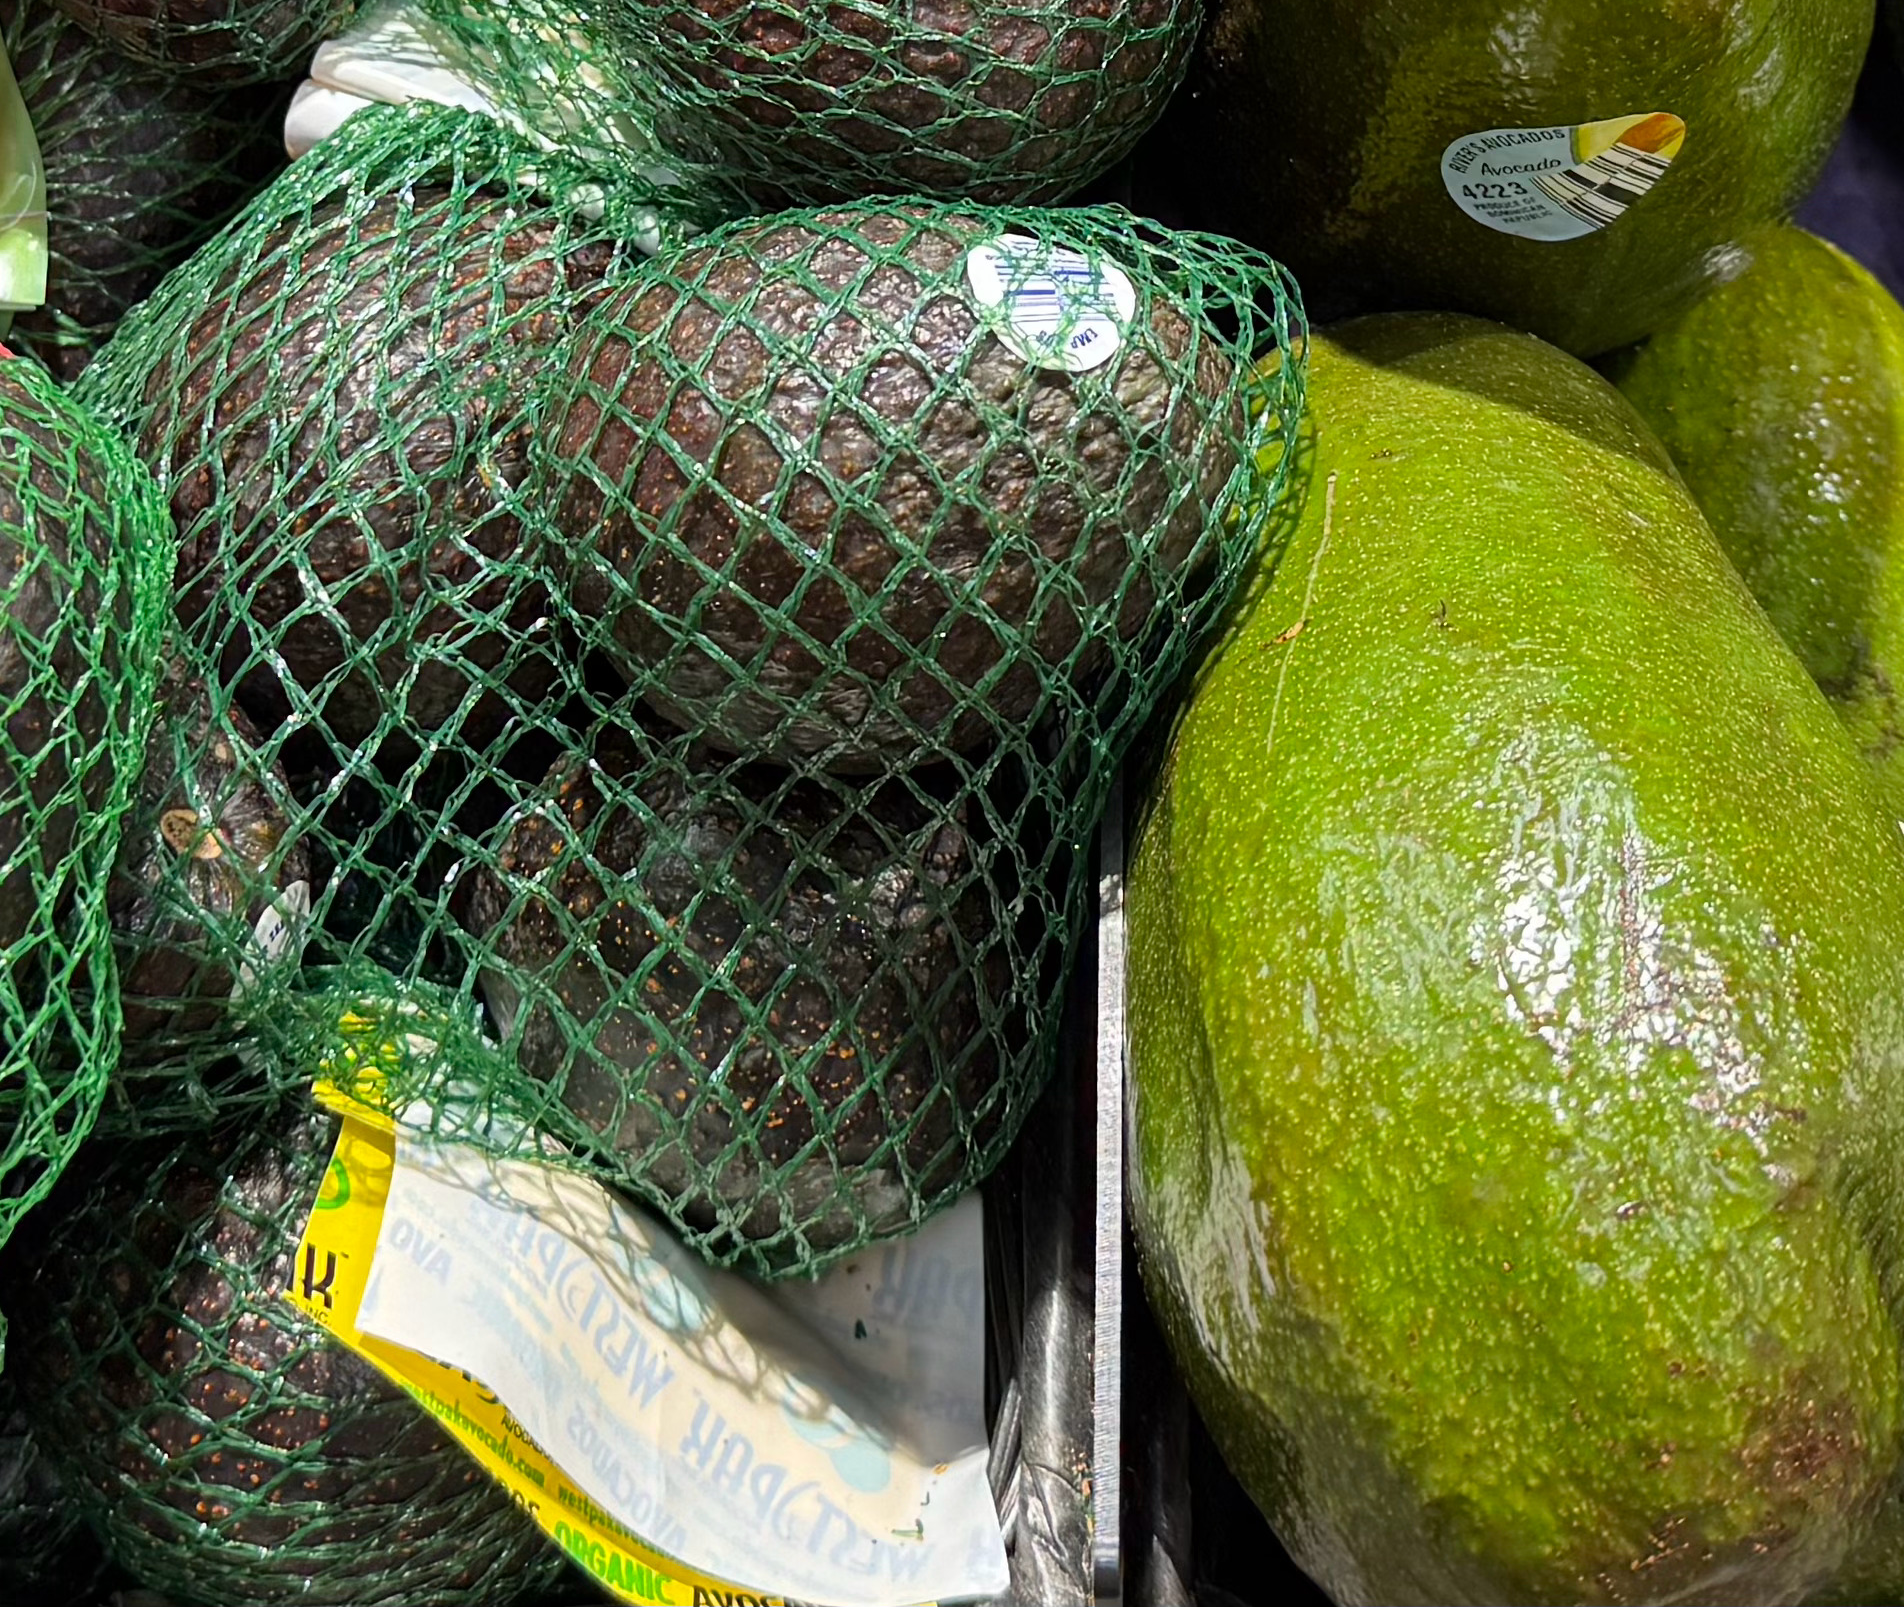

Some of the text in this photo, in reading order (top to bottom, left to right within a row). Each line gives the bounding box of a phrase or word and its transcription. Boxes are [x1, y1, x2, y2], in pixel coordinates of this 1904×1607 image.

[1449, 128, 1566, 174] RIVER'S AVOCADOS
[1481, 157, 1562, 178] Avocado
[1462, 181, 1528, 200] 4223
[554, 1520, 677, 1606] ORGANIC
